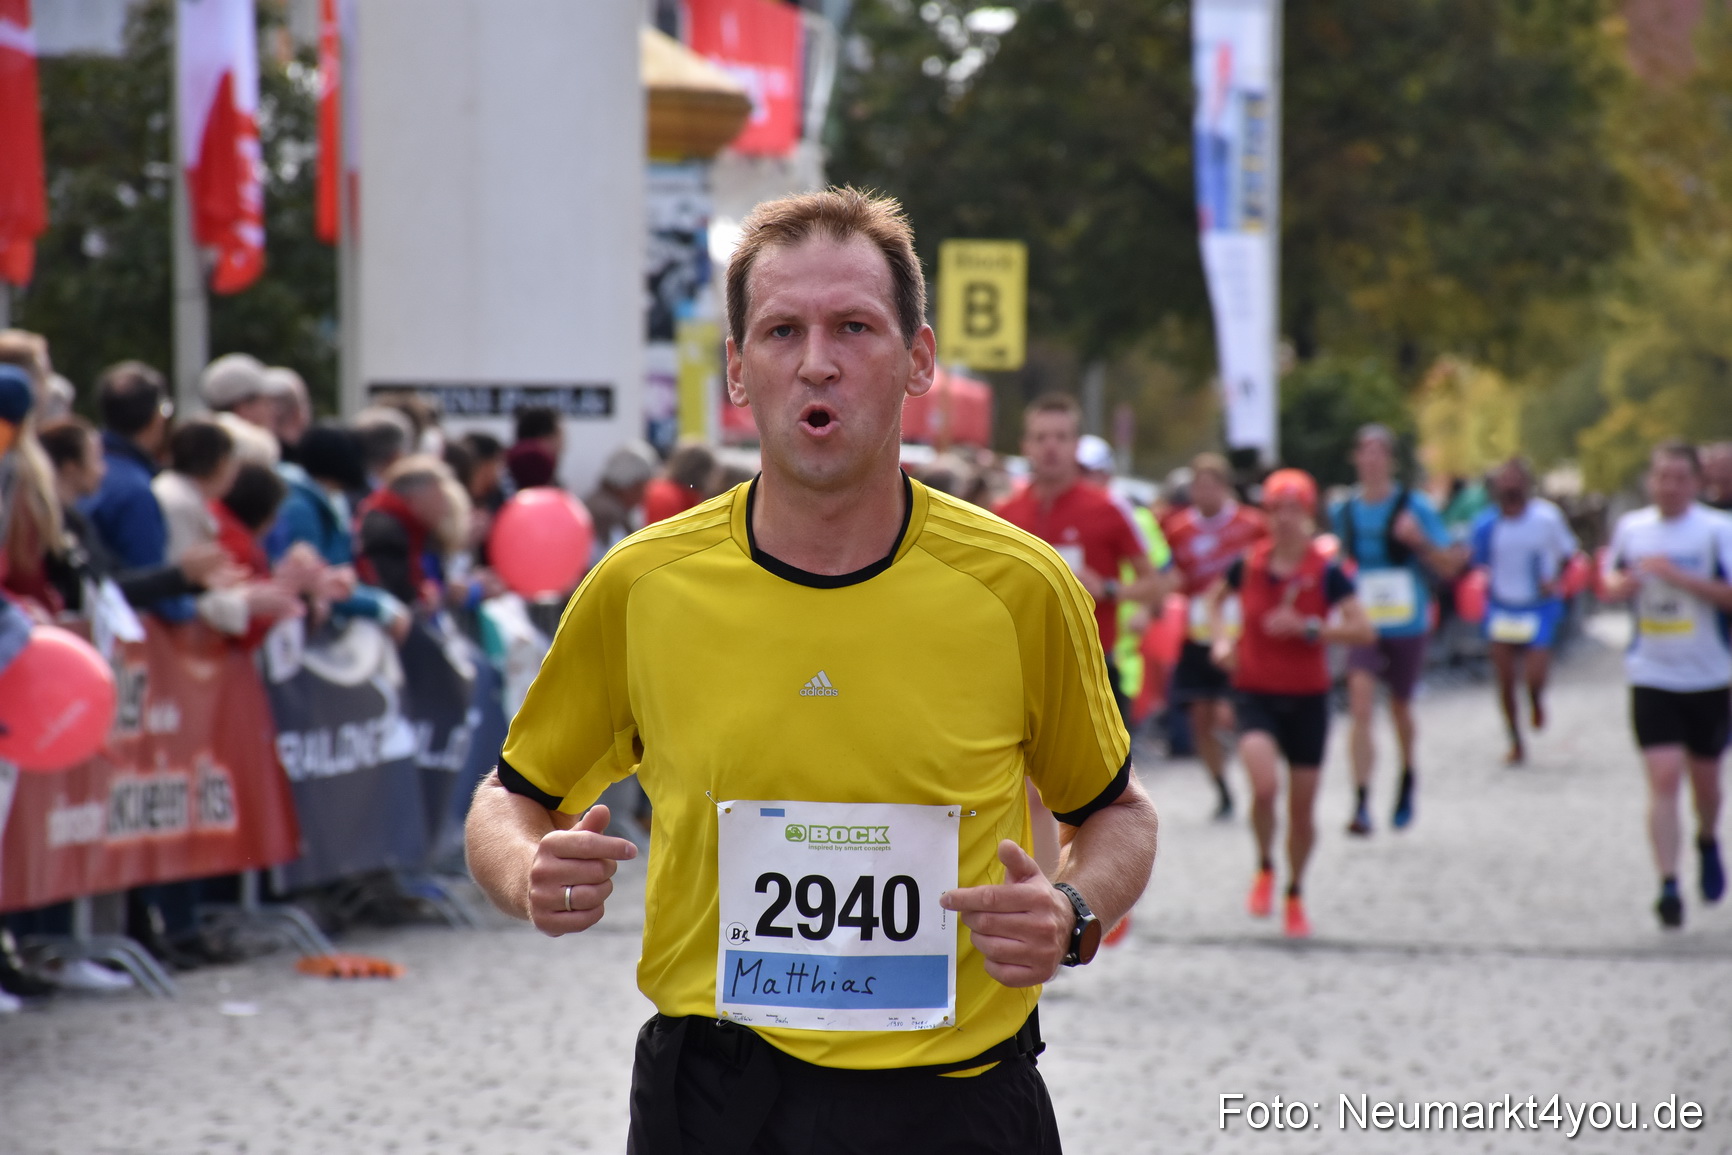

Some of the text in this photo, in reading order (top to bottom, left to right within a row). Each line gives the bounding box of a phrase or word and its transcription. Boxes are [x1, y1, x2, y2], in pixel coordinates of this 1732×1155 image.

[964, 281, 1001, 339] B
[800, 687, 838, 696] adidas
[809, 825, 890, 844] BOCK
[834, 844, 843, 852] by
[754, 872, 920, 942] 2940
[731, 957, 877, 998] Matthias
